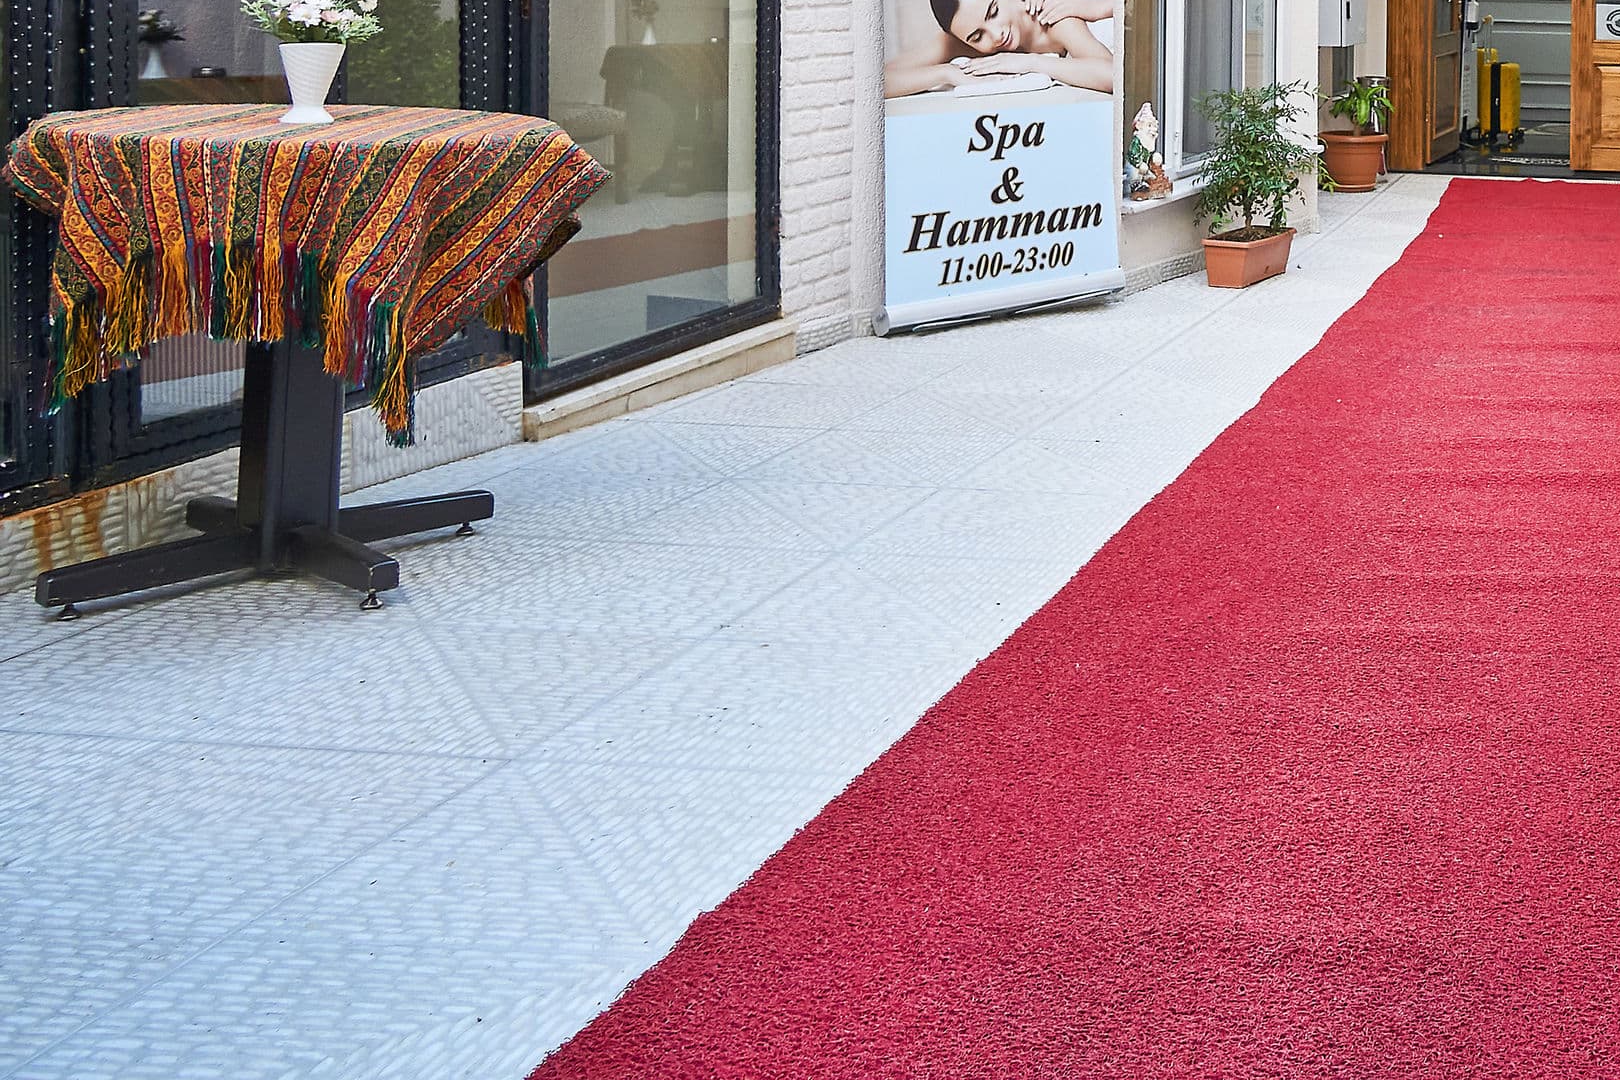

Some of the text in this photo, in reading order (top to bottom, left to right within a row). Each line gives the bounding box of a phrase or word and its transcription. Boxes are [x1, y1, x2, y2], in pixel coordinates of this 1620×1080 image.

[967, 113, 1045, 161] Spa
[990, 166, 1025, 204] &
[902, 201, 1103, 254] Hammam
[937, 241, 1075, 286] 11:00-23:00
